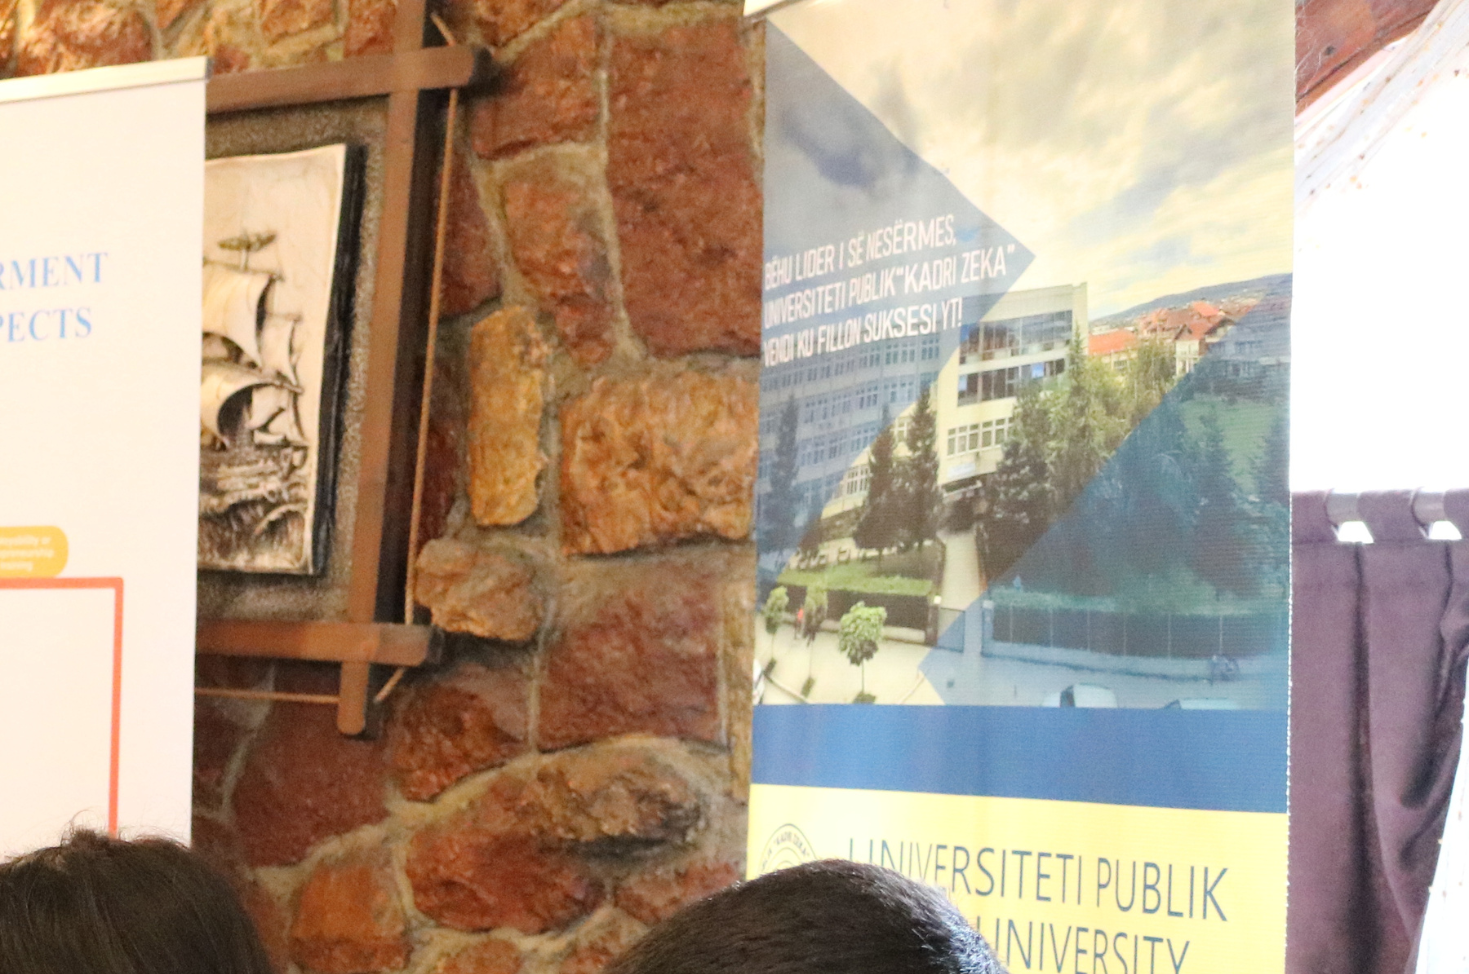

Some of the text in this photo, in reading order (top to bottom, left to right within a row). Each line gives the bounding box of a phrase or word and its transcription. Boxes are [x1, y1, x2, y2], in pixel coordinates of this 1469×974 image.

[796, 244, 835, 281] LIDER
[839, 241, 844, 270] I
[866, 214, 957, 261] NESËRMES,
[764, 281, 846, 329] UNIVERSITETI
[797, 327, 815, 358] KU
[817, 316, 861, 355] FILLON
[864, 303, 937, 343] SUKSESI
[941, 296, 963, 331] YT!
[1096, 857, 1228, 922] PUBLIK
